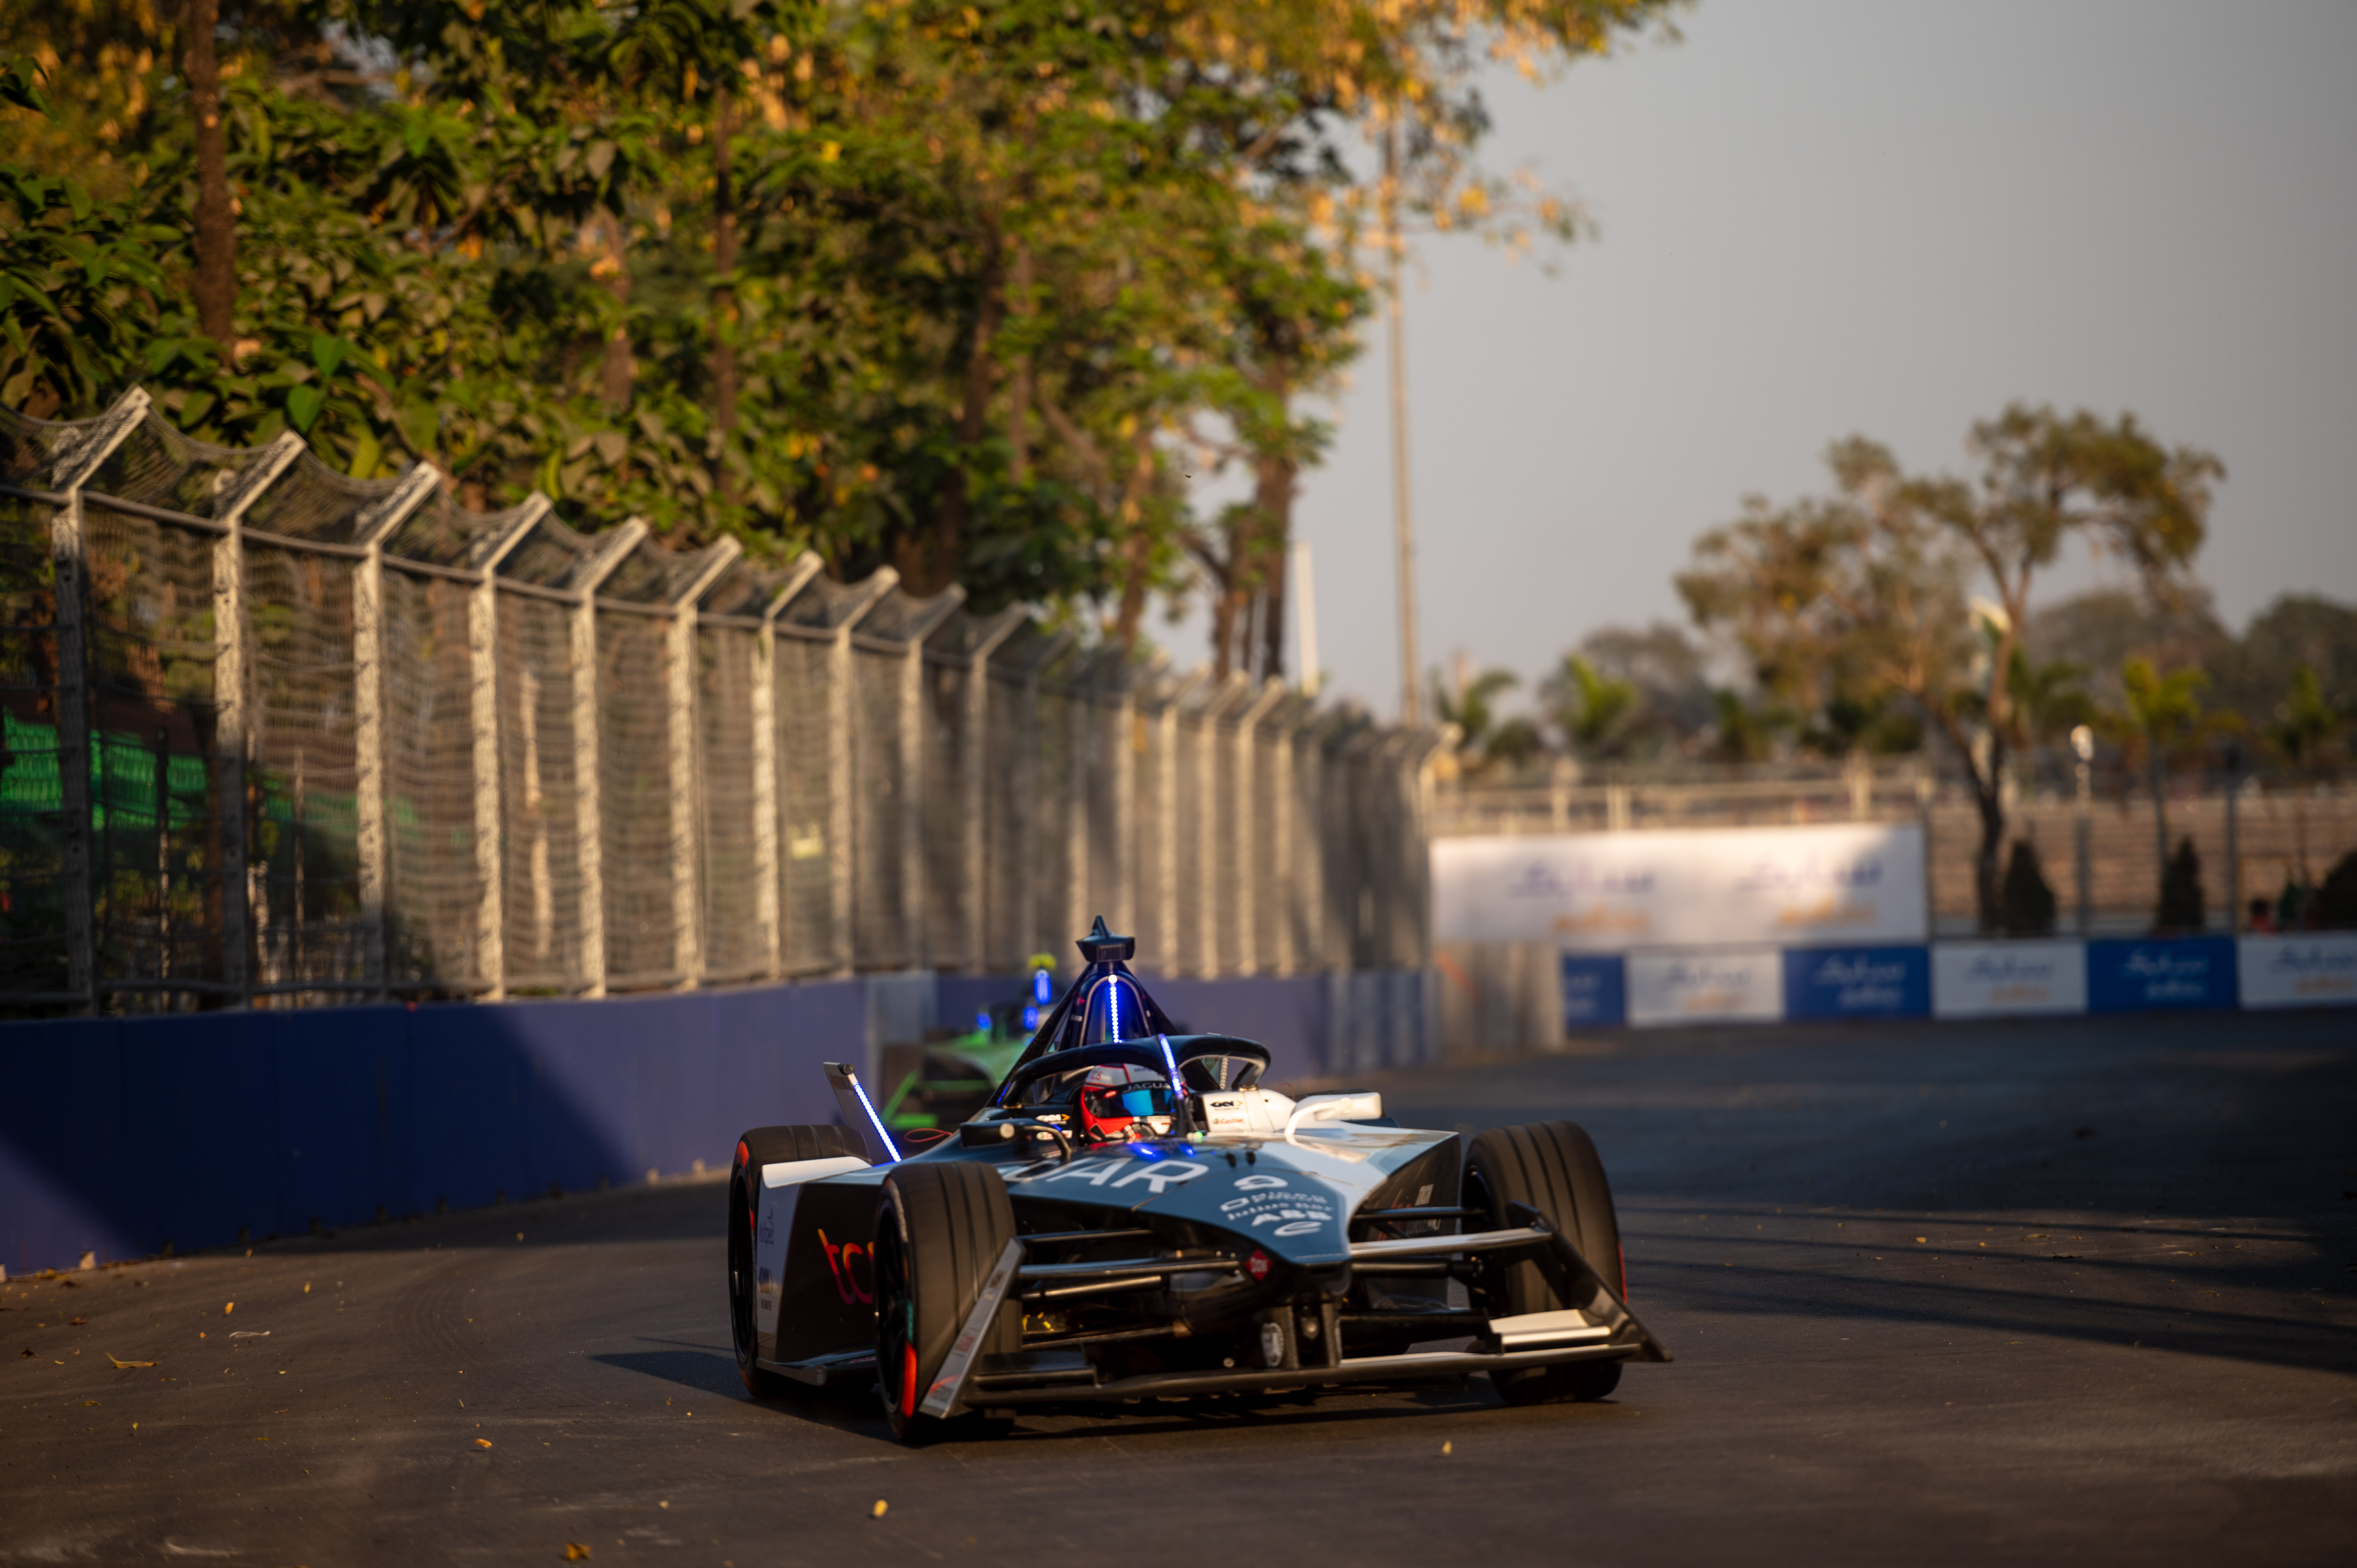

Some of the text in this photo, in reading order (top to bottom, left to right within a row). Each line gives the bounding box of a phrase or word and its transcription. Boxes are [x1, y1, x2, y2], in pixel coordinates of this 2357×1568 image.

[1123, 1082, 1172, 1092] JAGUA
[996, 1157, 1209, 1193] UAR
[818, 1228, 874, 1305] tc
